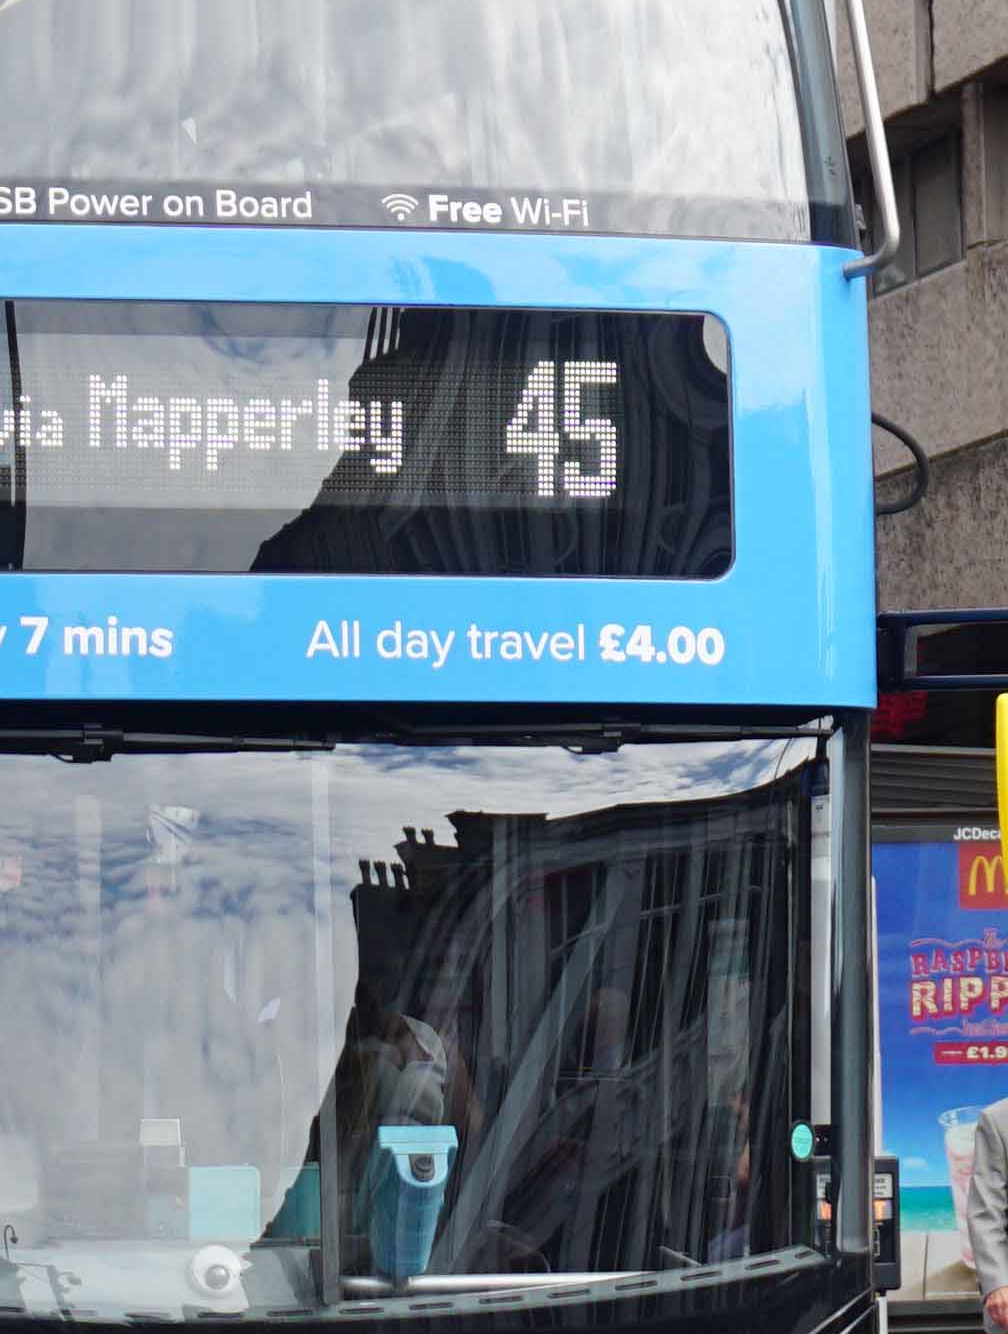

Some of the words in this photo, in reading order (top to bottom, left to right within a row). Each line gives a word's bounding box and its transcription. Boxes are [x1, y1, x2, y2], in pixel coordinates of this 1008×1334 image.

[49, 186, 152, 216] Power
[162, 193, 204, 216] on
[216, 189, 313, 219] Board
[428, 194, 503, 224] Free
[510, 196, 589, 227] Wi-Fi
[89, 374, 403, 473] Mapperley
[506, 360, 618, 497] 45
[19, 615, 49, 655] 7
[63, 616, 174, 658] mins
[305, 620, 361, 659] All
[375, 620, 455, 668] day
[467, 623, 586, 661] travel
[598, 623, 725, 666] £4.00
[953, 827, 1001, 841] JCDec
